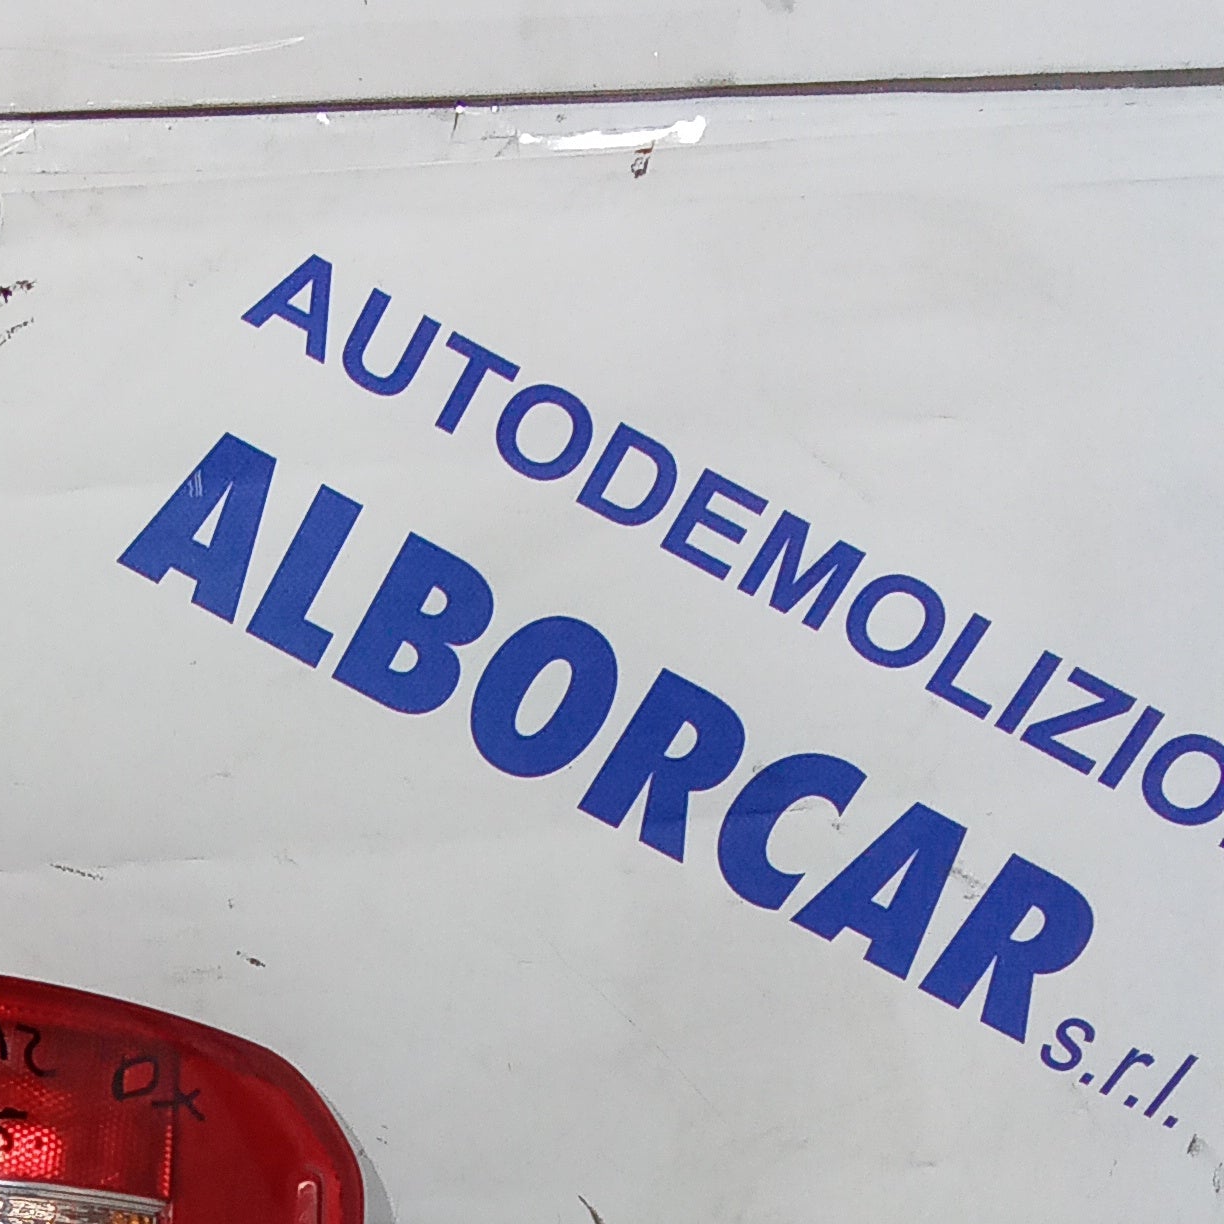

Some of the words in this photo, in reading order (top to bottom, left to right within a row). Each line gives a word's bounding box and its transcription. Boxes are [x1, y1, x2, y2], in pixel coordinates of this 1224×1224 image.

[119, 432, 1095, 1045] ALBORCAR
[1040, 1017, 1199, 1128] s.r.l.
[243, 254, 1224, 848] AUTODEMOLIZIO
